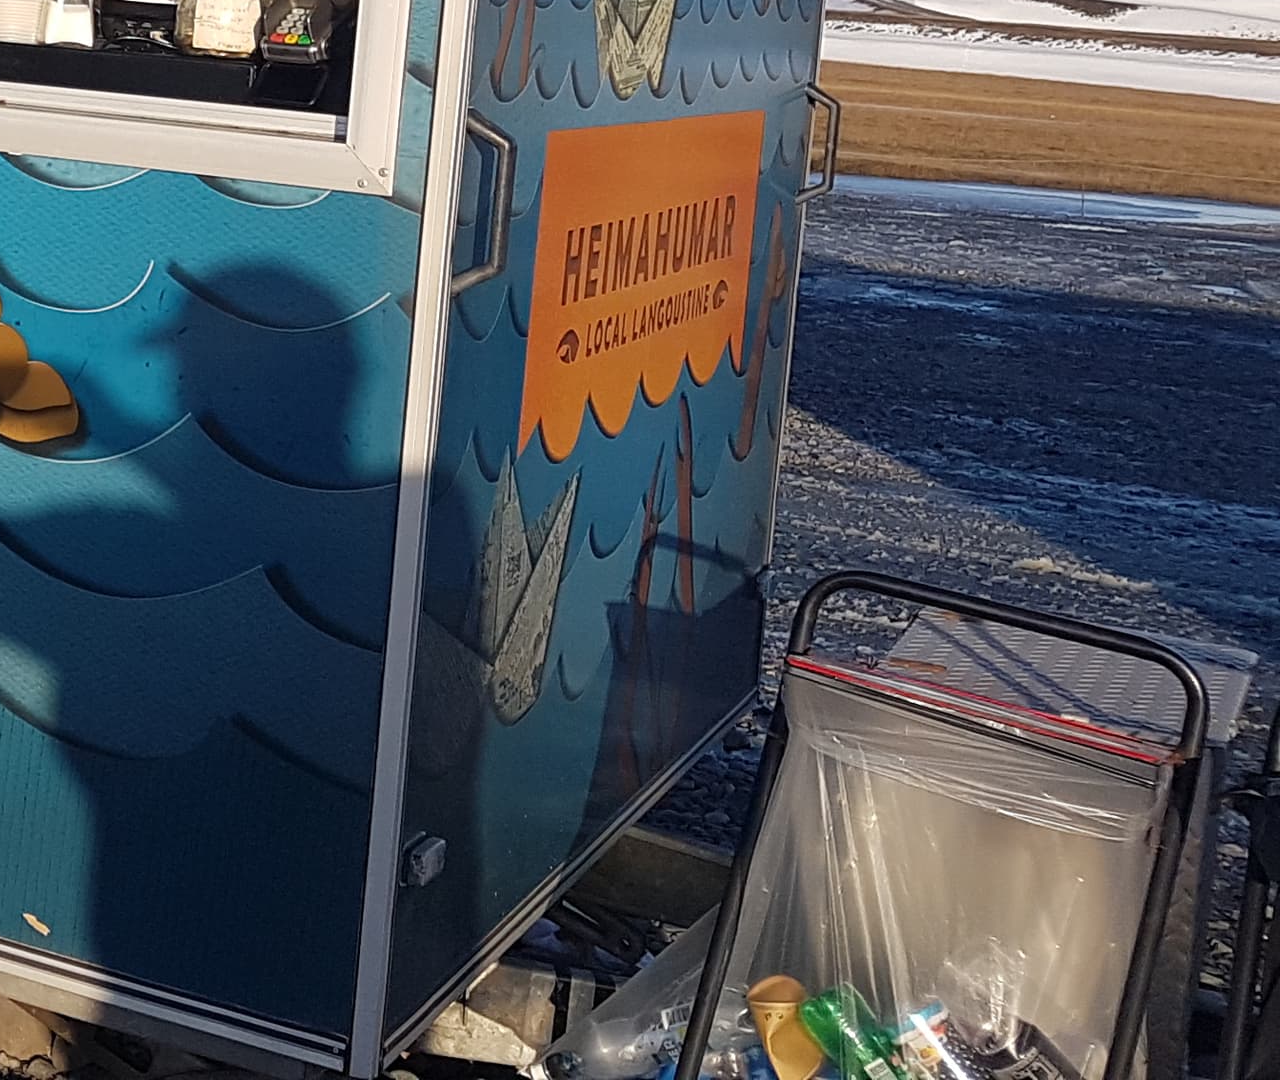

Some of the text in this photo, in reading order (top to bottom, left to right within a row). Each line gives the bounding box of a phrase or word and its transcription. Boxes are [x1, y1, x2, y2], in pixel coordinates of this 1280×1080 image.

[561, 195, 737, 306] HEIMAHUMAR
[585, 284, 710, 358] LOCAL LANGOUSTINE
